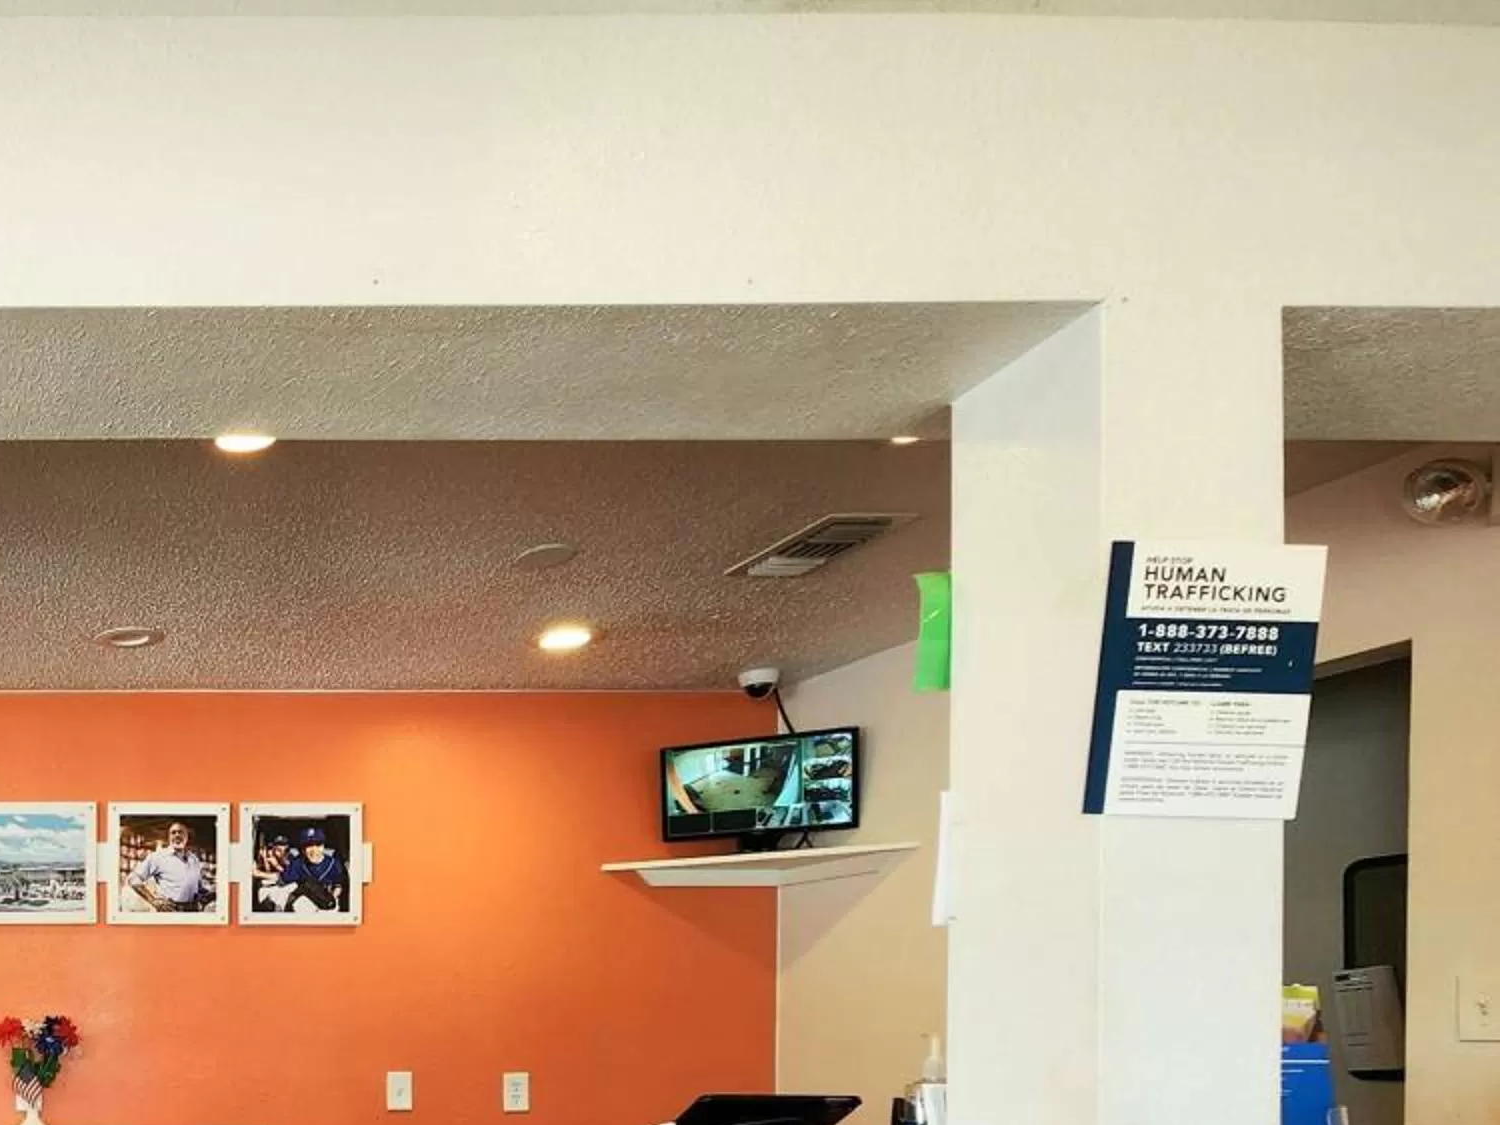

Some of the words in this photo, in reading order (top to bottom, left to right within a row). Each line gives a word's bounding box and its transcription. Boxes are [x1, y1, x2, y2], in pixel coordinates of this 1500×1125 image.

[1144, 566, 1226, 583] HUMAN
[1143, 584, 1287, 603] TRAFFICKING
[1138, 623, 1279, 641] 1-888-373-7888
[1136, 641, 1170, 653] TEXT
[1219, 644, 1277, 656] (BEFREE)
